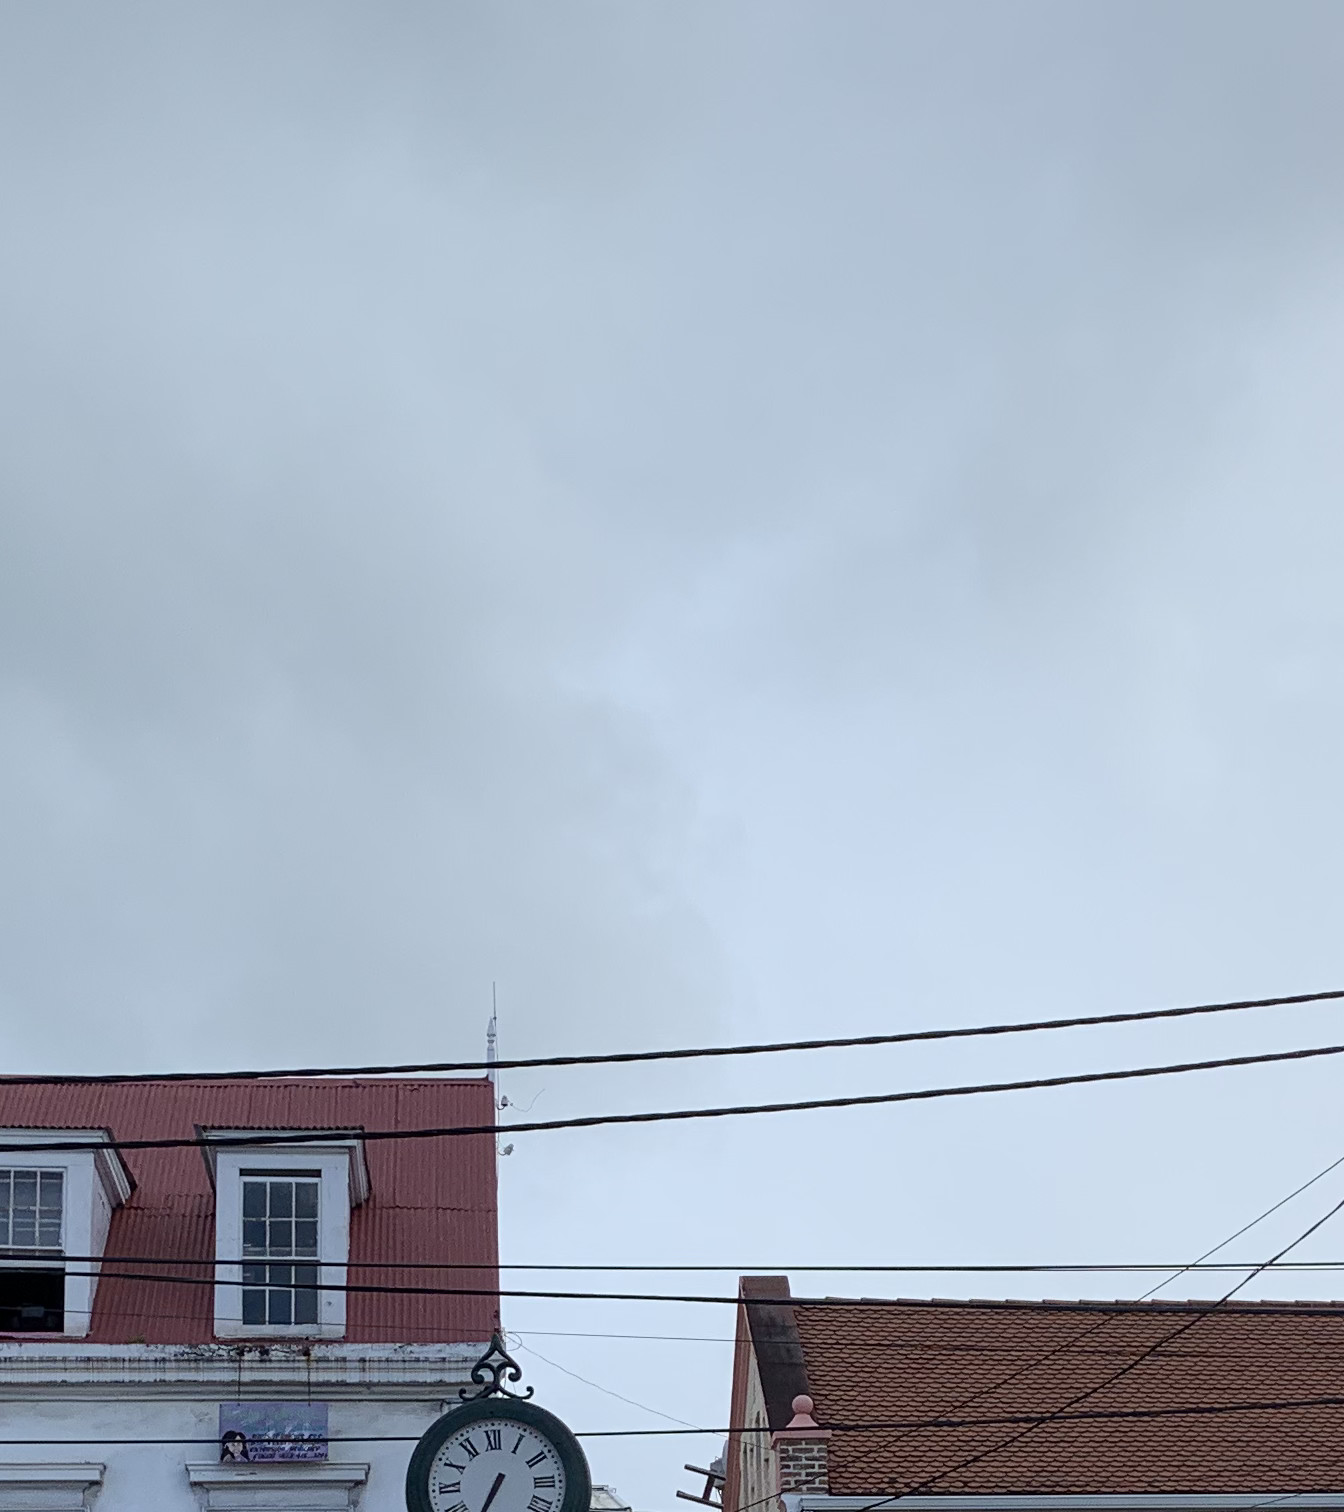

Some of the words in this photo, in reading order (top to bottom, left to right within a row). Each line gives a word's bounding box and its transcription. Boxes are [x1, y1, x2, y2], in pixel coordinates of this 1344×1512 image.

[459, 1437, 480, 1461] XI
[484, 1429, 502, 1452] XII
[511, 1433, 526, 1454] I
[444, 1458, 466, 1474] X
[526, 1451, 548, 1468] II
[439, 1481, 460, 1494] IX
[534, 1474, 555, 1489] III
